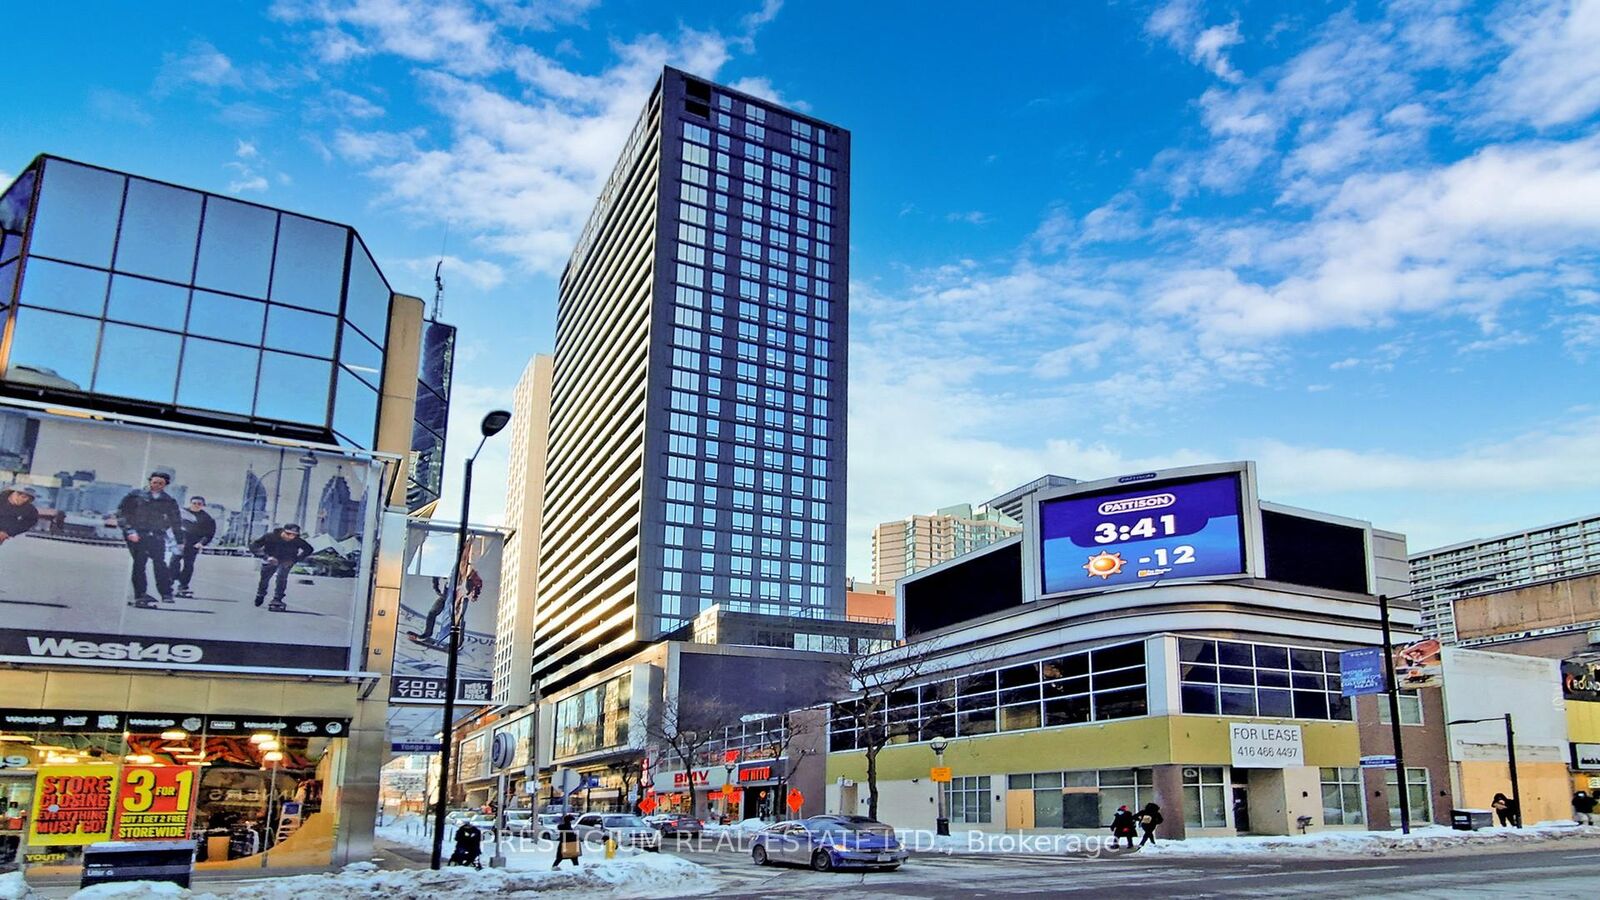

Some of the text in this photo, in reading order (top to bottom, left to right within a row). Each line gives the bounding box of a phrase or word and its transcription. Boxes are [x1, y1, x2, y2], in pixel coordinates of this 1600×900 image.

[1103, 496, 1169, 512] PATTISON
[1094, 515, 1176, 543] 3:41
[1138, 545, 1196, 566] -12
[26, 636, 203, 663] West49
[398, 680, 438, 689] ZOO
[398, 689, 447, 698] YORK
[1233, 728, 1298, 741] FOR LEASE
[1238, 746, 1256, 757] 416
[1276, 748, 1298, 758] 4497
[674, 770, 709, 783] BMV
[43, 776, 113, 795] STORE
[123, 769, 194, 813] 3 FOR 1
[40, 794, 110, 808] CLOSING
[38, 810, 107, 821] EVERYTHING
[120, 815, 137, 823] BUY
[143, 815, 159, 823] GET
[167, 815, 187, 823] FREE
[36, 820, 106, 834] MUST GO!
[119, 826, 185, 839] STOREWIDE
[26, 853, 66, 862] YOUTH
